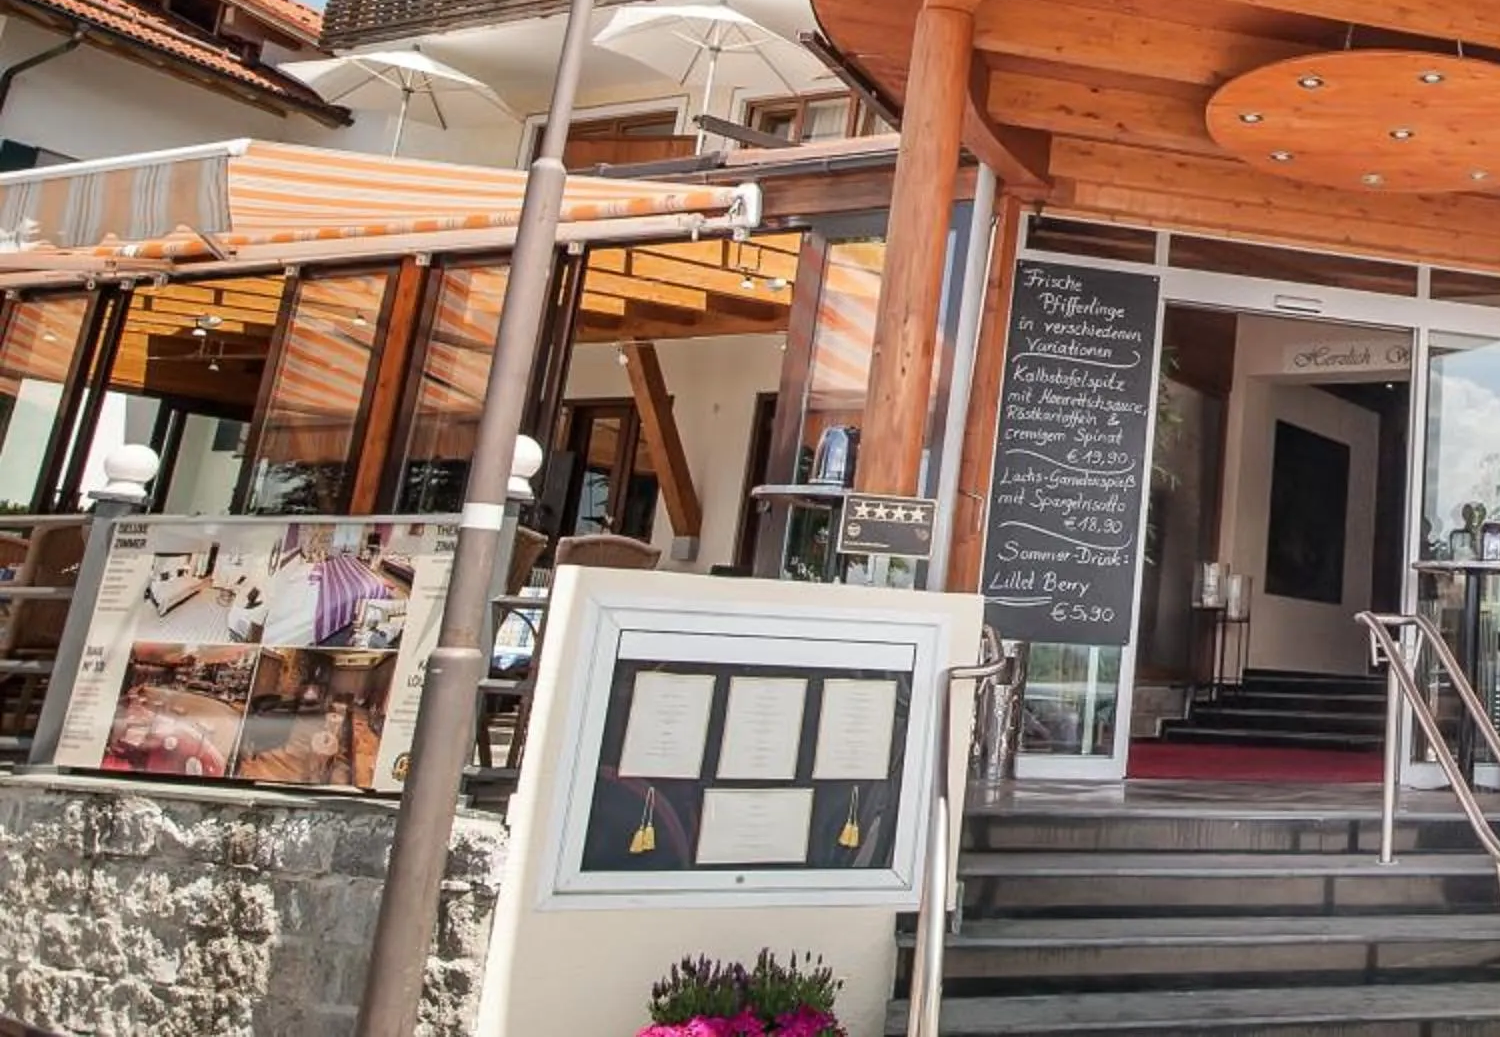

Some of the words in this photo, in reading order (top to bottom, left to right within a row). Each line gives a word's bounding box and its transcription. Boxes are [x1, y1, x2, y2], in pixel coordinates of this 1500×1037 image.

[1022, 267, 1083, 292] Frische
[1039, 291, 1125, 322] Pfifferlinge
[1018, 315, 1035, 331] in
[1025, 337, 1113, 359] Variationen
[1013, 364, 1126, 394] Kalbstafelspitz
[1007, 386, 1033, 404] mit
[1073, 426, 1124, 448] Spinat
[998, 486, 1025, 505] mit
[1042, 570, 1091, 598] Berry
